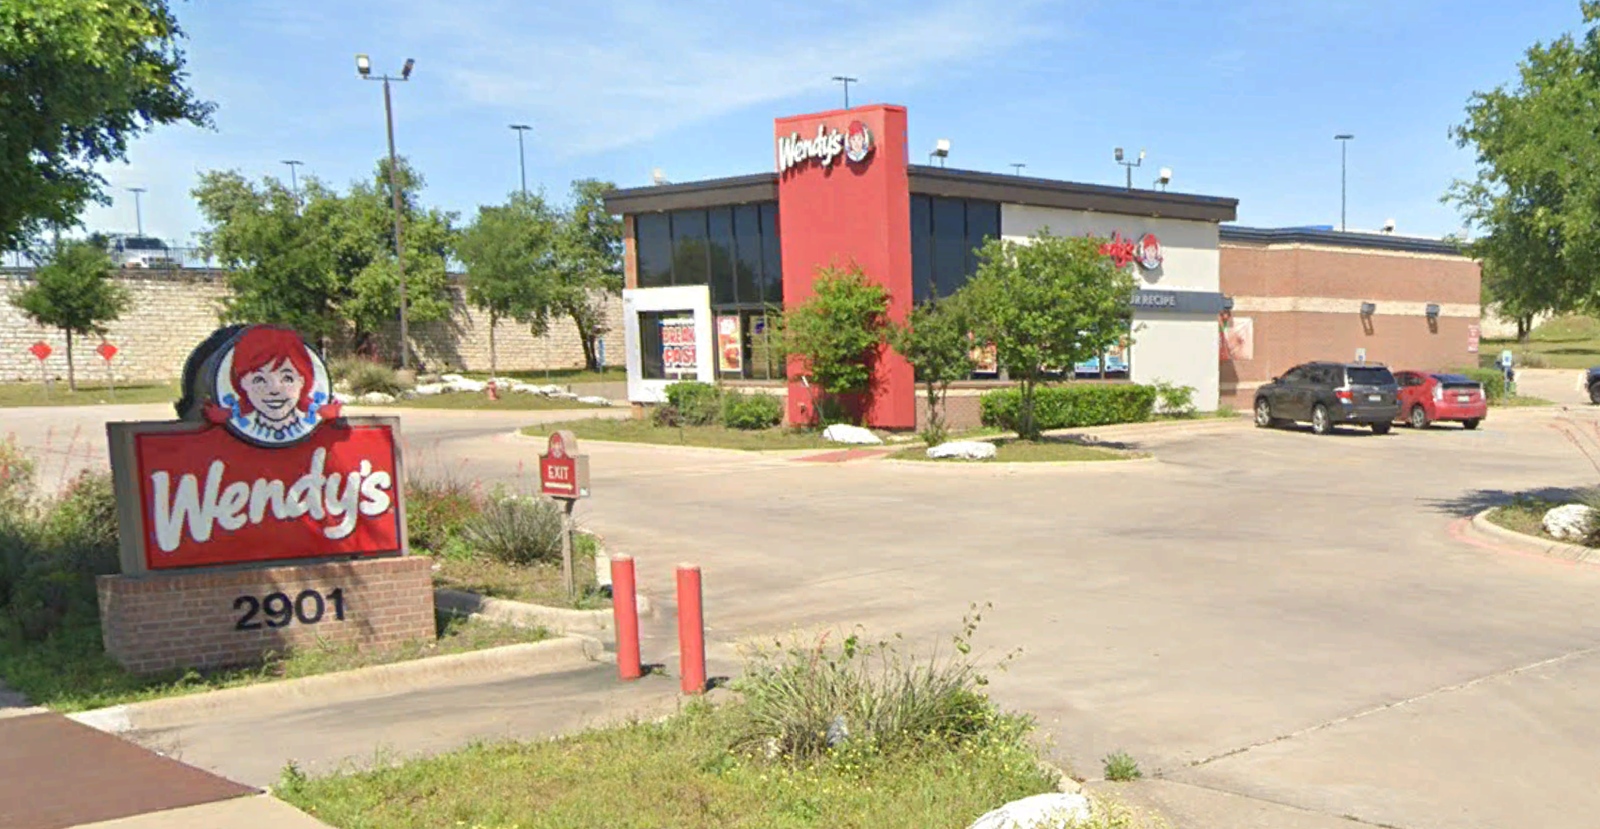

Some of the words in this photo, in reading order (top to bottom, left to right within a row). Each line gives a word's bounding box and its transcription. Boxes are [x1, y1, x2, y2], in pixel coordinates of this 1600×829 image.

[779, 124, 842, 172] Wendy's
[1142, 295, 1176, 307] RECIPE
[662, 326, 696, 344] BREAK
[664, 346, 696, 363] FAST
[548, 465, 569, 480] EXIT
[151, 447, 392, 552] Wendy's
[232, 587, 347, 631] 2901
